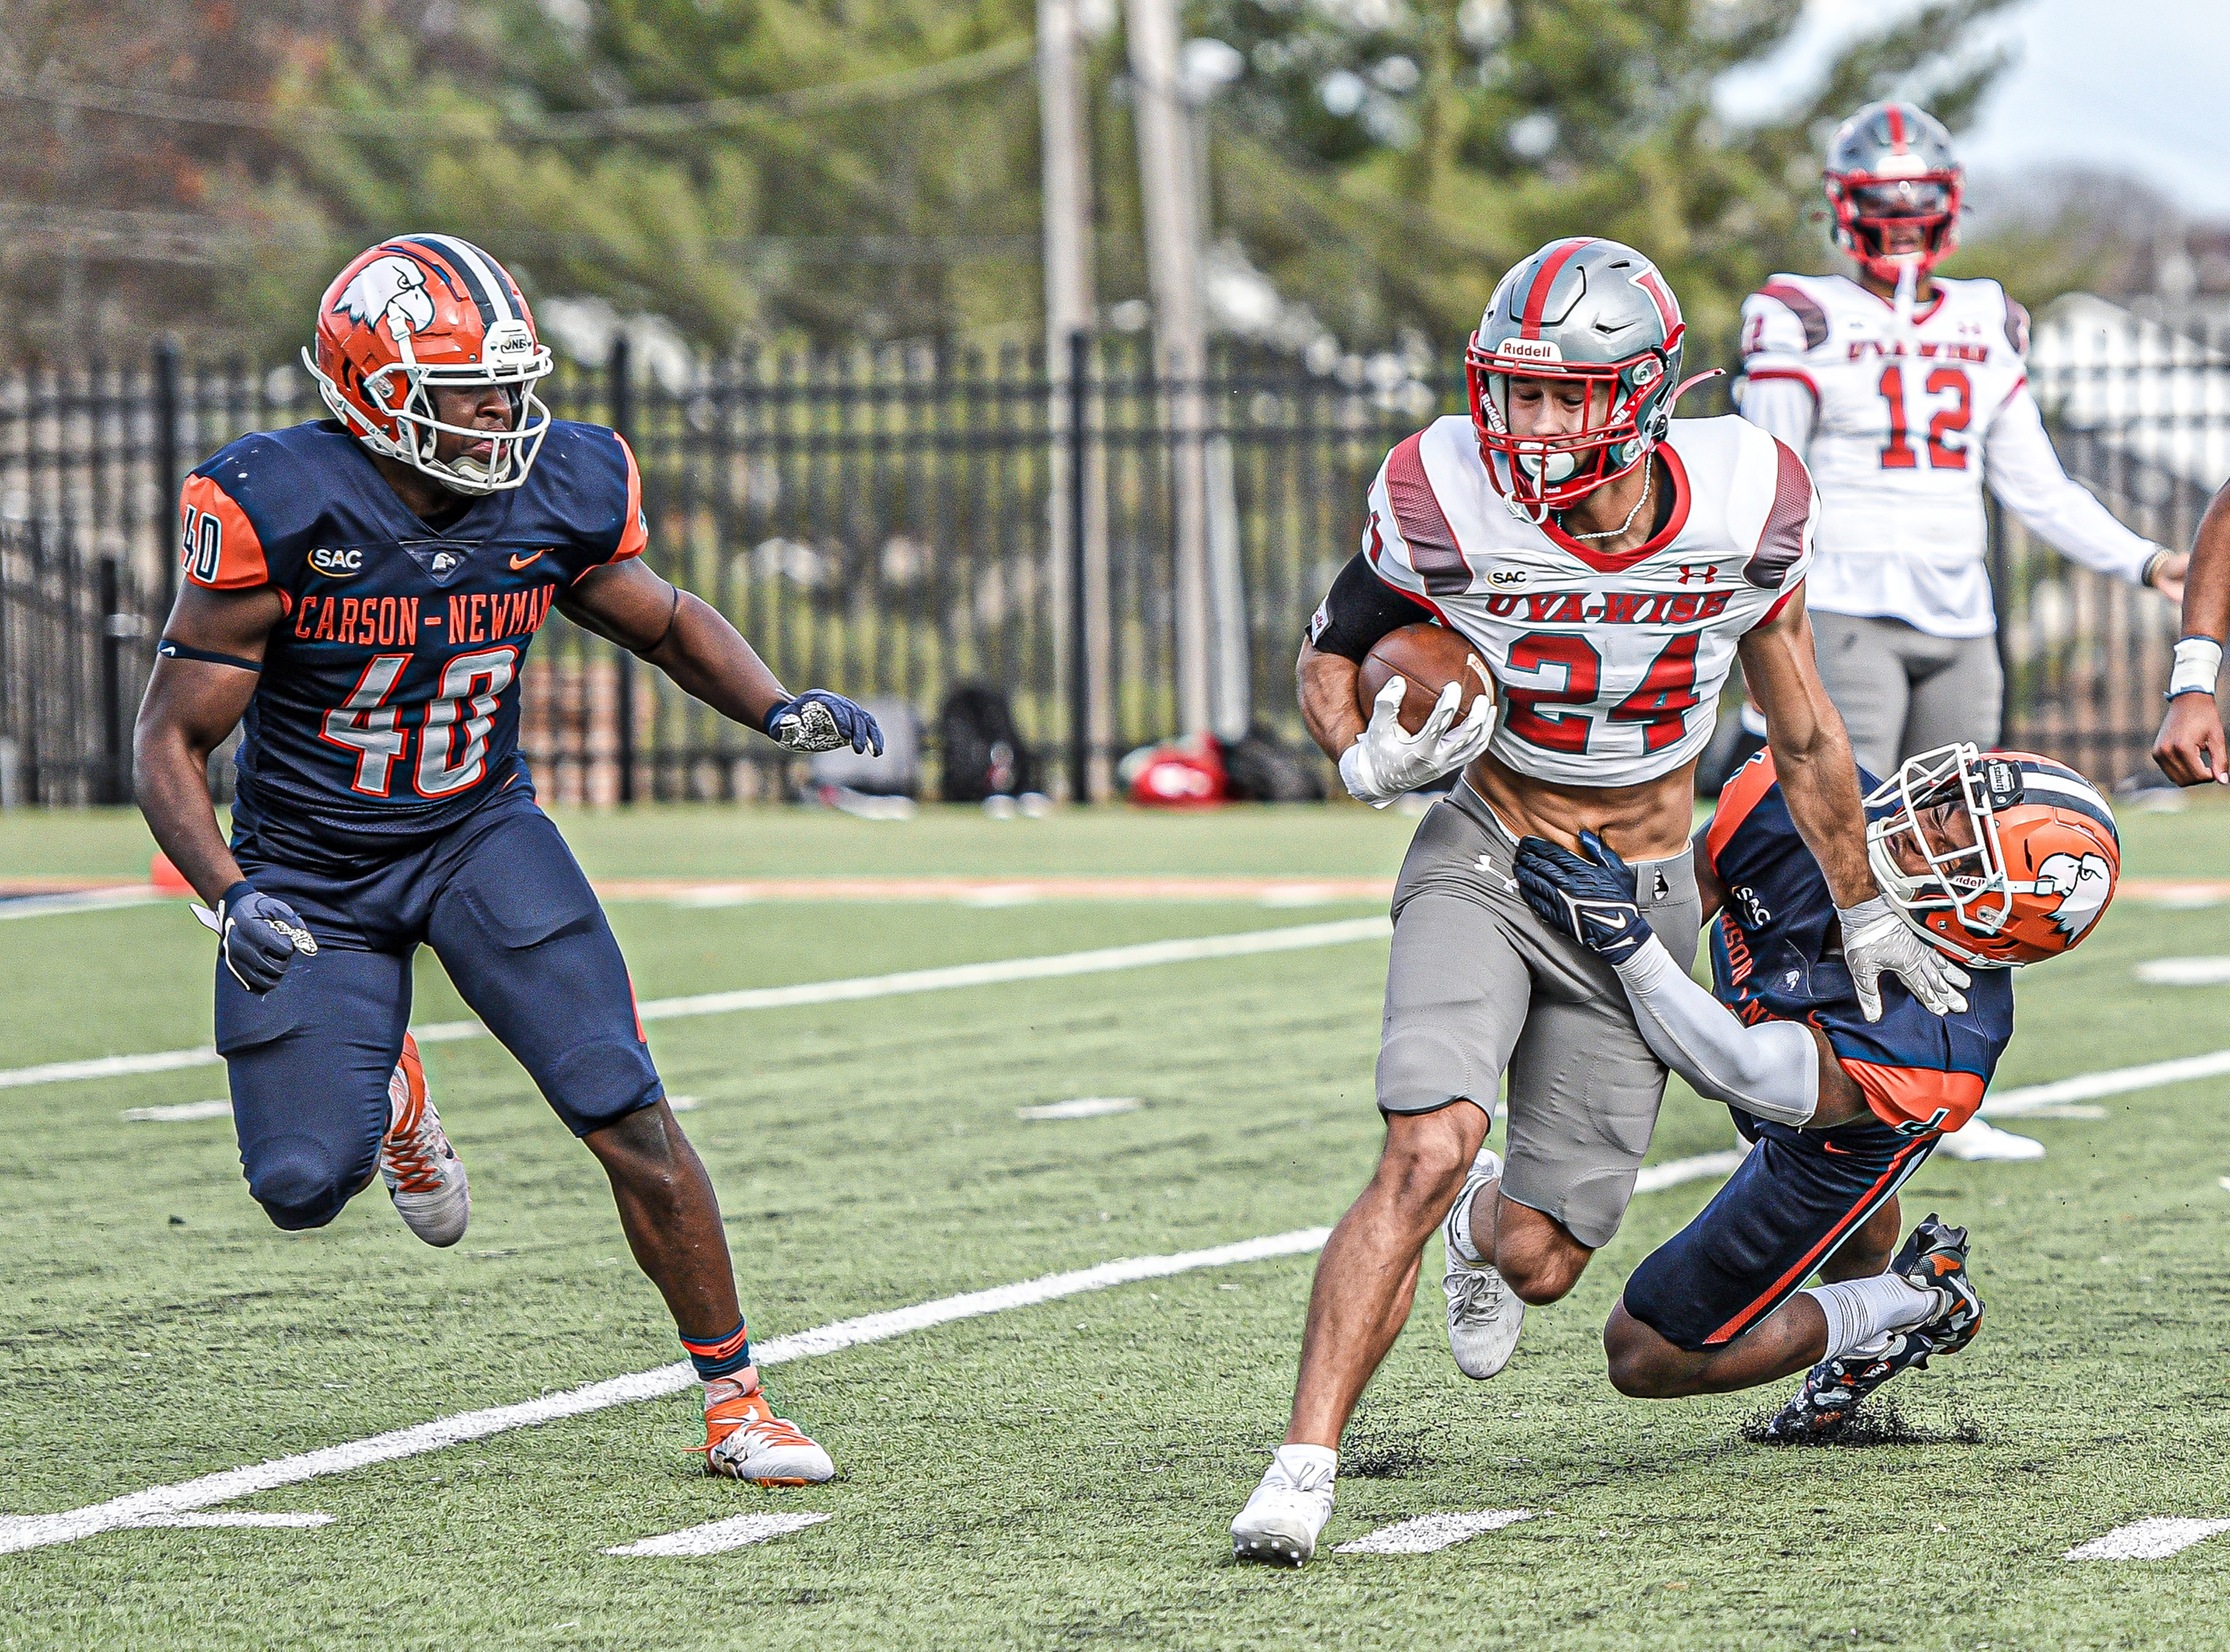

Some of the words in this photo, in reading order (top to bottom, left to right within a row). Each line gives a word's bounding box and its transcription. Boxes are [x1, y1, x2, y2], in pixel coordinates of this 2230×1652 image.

[1504, 343, 1551, 357] Riddell
[1878, 365, 1971, 470] 12
[182, 504, 222, 583] 40
[314, 548, 363, 570] SAC
[1493, 571, 1527, 584] SAC
[1485, 590, 1735, 626] UVA-WISE
[1504, 629, 1702, 756] 24
[318, 645, 519, 798] 40
[1736, 887, 1771, 926] SAC
